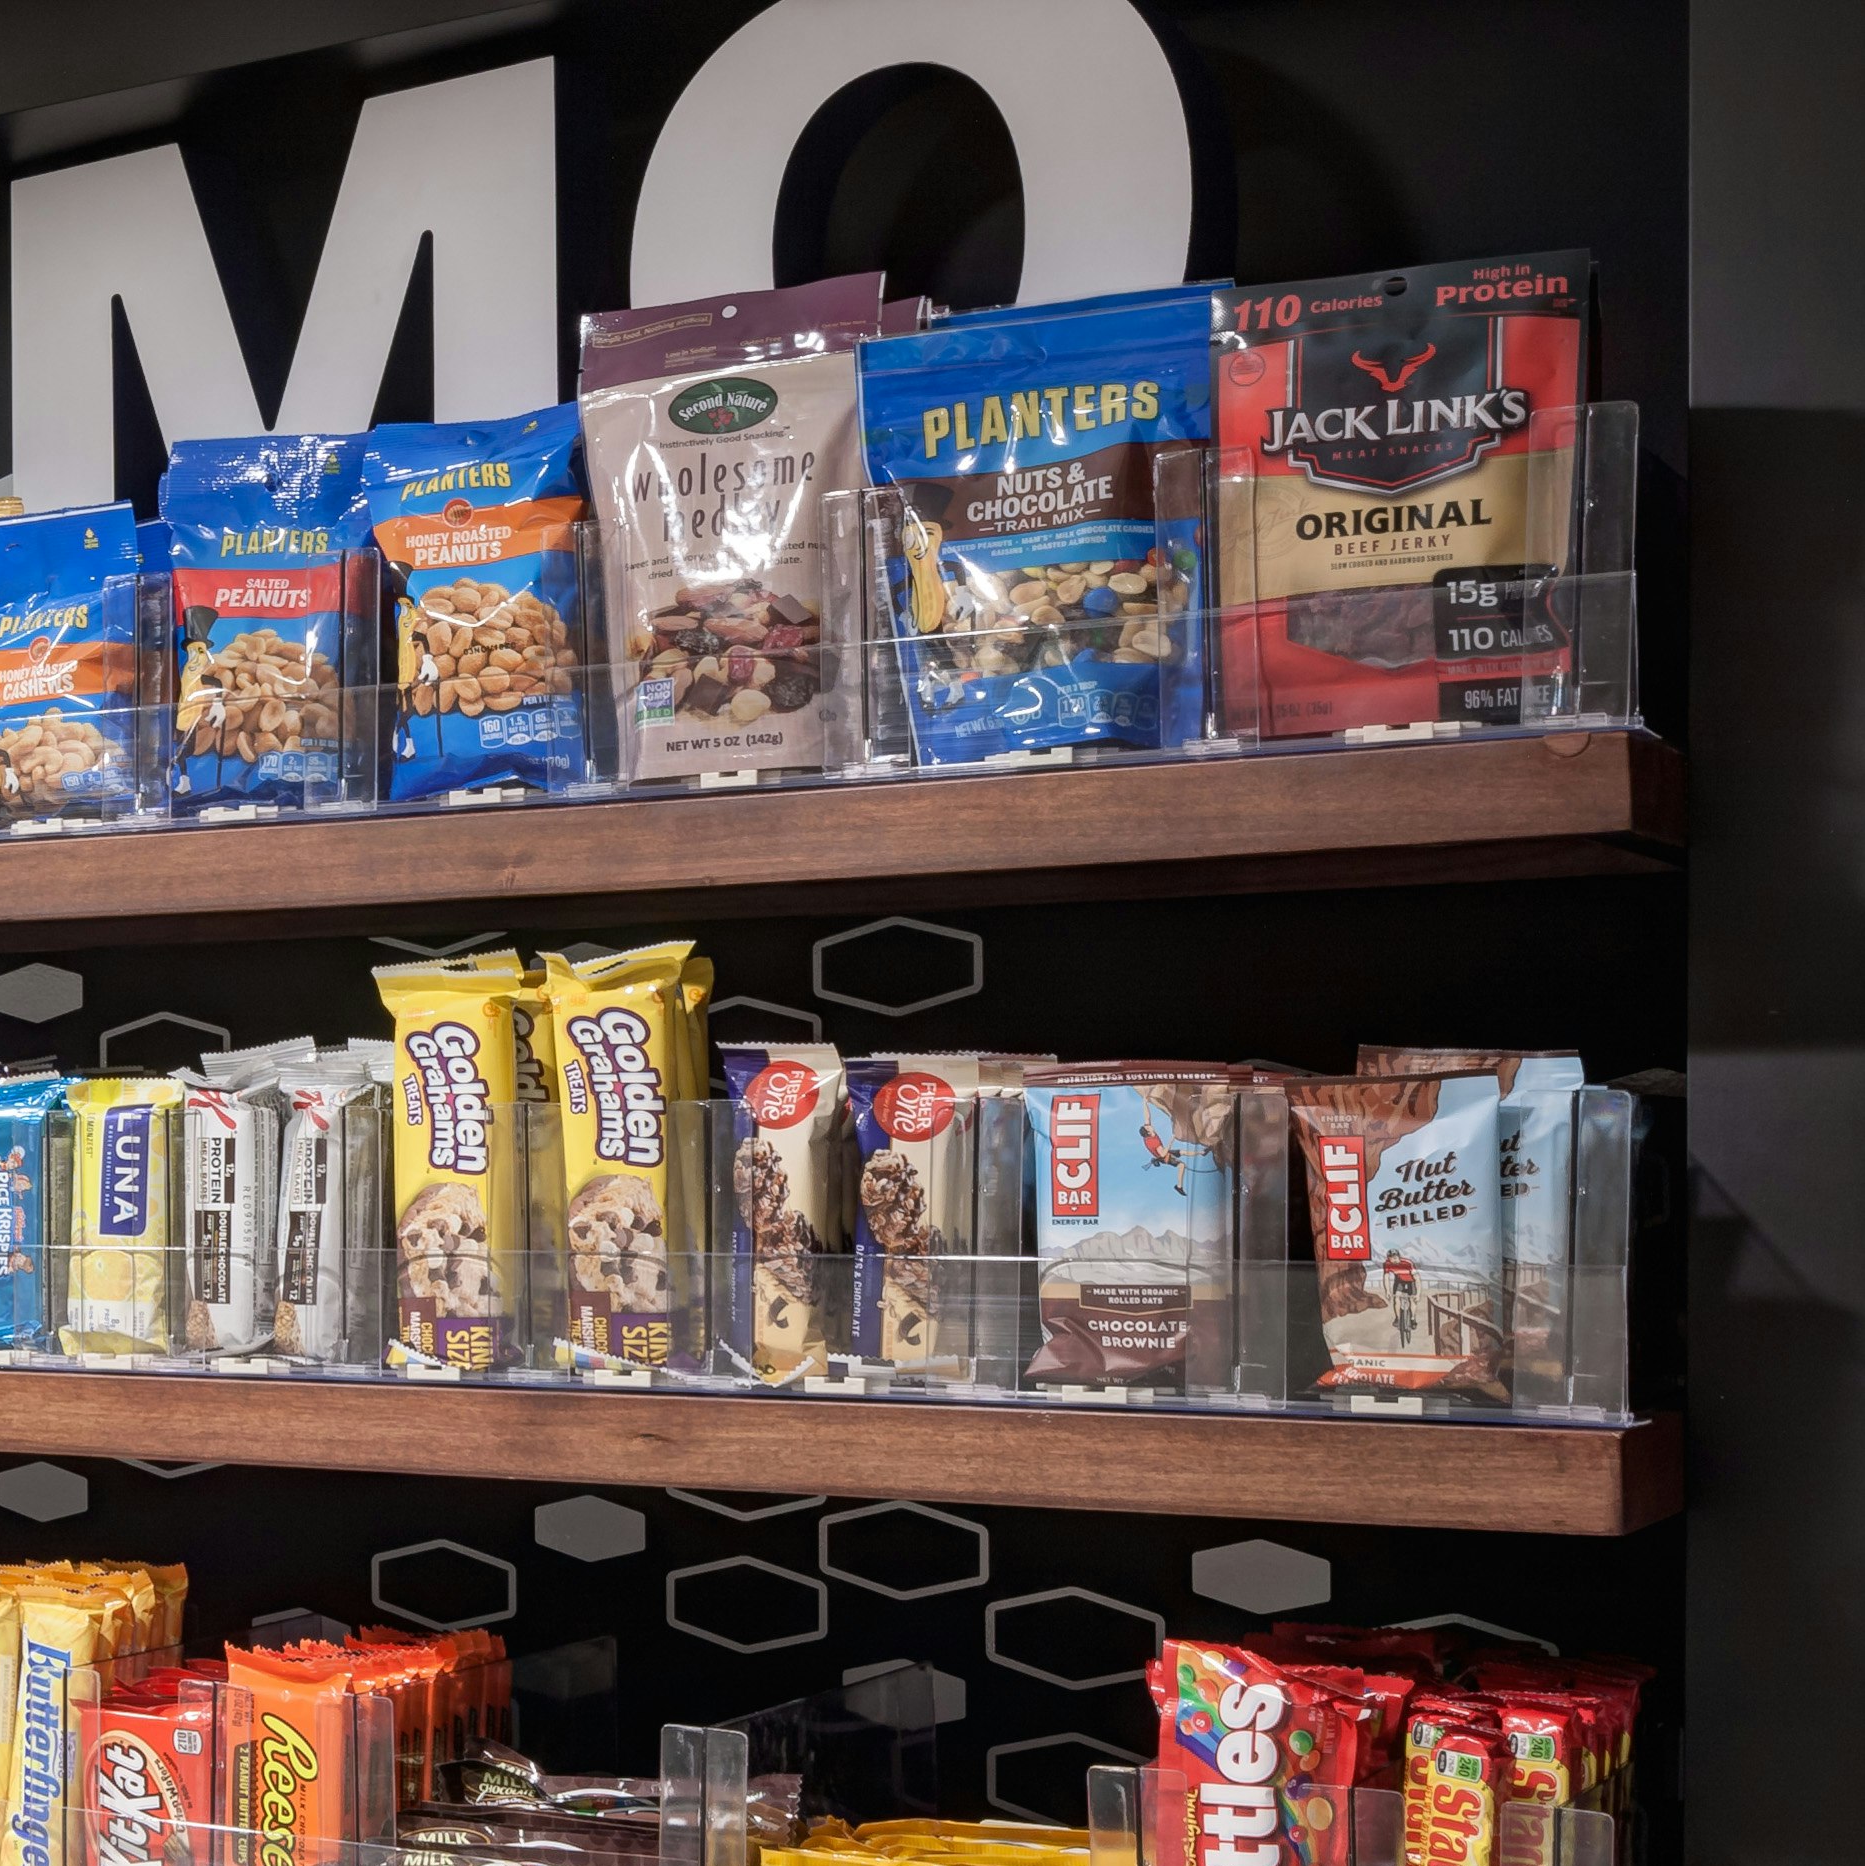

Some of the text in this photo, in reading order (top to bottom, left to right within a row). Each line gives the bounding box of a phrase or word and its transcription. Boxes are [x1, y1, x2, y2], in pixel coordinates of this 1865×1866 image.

[1473, 264, 1530, 281] High in
[1436, 274, 1568, 307] Protein
[1233, 293, 1382, 331] 110 Calories
[679, 392, 768, 421] Second Nature
[922, 381, 1160, 459] PLANTERS
[1264, 389, 1527, 452] JACK LINK'S
[1332, 441, 1454, 461] MEAT SNACKS
[401, 462, 511, 501] PLANTERS
[997, 463, 1086, 497] NUTS &
[967, 475, 1113, 523] CHOCOLATE
[1295, 498, 1492, 541] ORIGINAL
[221, 529, 328, 557] PLANTERS
[406, 526, 511, 549] HONEY ROASTED
[415, 541, 502, 566] PEANUTS
[1334, 534, 1452, 556] BEEF JERKY
[214, 588, 311, 608] PEANUTS
[246, 579, 289, 589] SALTED
[1447, 580, 1498, 607] 15g
[403, 1074, 422, 1125] TREATS
[407, 1034, 456, 1167] Grahams
[434, 1023, 487, 1173] Golden
[564, 1059, 582, 1114] TREATS
[570, 1017, 618, 1159] Grahams
[603, 1010, 662, 1166] Golden
[760, 1074, 790, 1122] One
[781, 1070, 805, 1117] FIBER
[894, 1083, 920, 1134] One
[918, 1082, 938, 1130] FIBER
[1321, 1114, 1359, 1123] ENERGY
[1056, 1101, 1093, 1189] CLIF
[113, 1113, 143, 1225] LUNA
[210, 1137, 222, 1204] PROTEIN
[1395, 1151, 1456, 1183] Nut
[1058, 1190, 1091, 1206] BAR
[1324, 1144, 1363, 1234] CLIF
[1375, 1179, 1476, 1213] Butter
[1052, 1218, 1099, 1226] ENERGY BAR
[1386, 1204, 1467, 1230] FILLED
[1331, 1235, 1364, 1249] BAR
[1094, 1288, 1179, 1296] MADE WITH ORGANIC
[1108, 1297, 1163, 1305] ROLLED OATS
[1088, 1320, 1188, 1333] CHOCOLATE
[1102, 1336, 1175, 1349] BROWNIE
[404, 1851, 454, 1866] MILK
